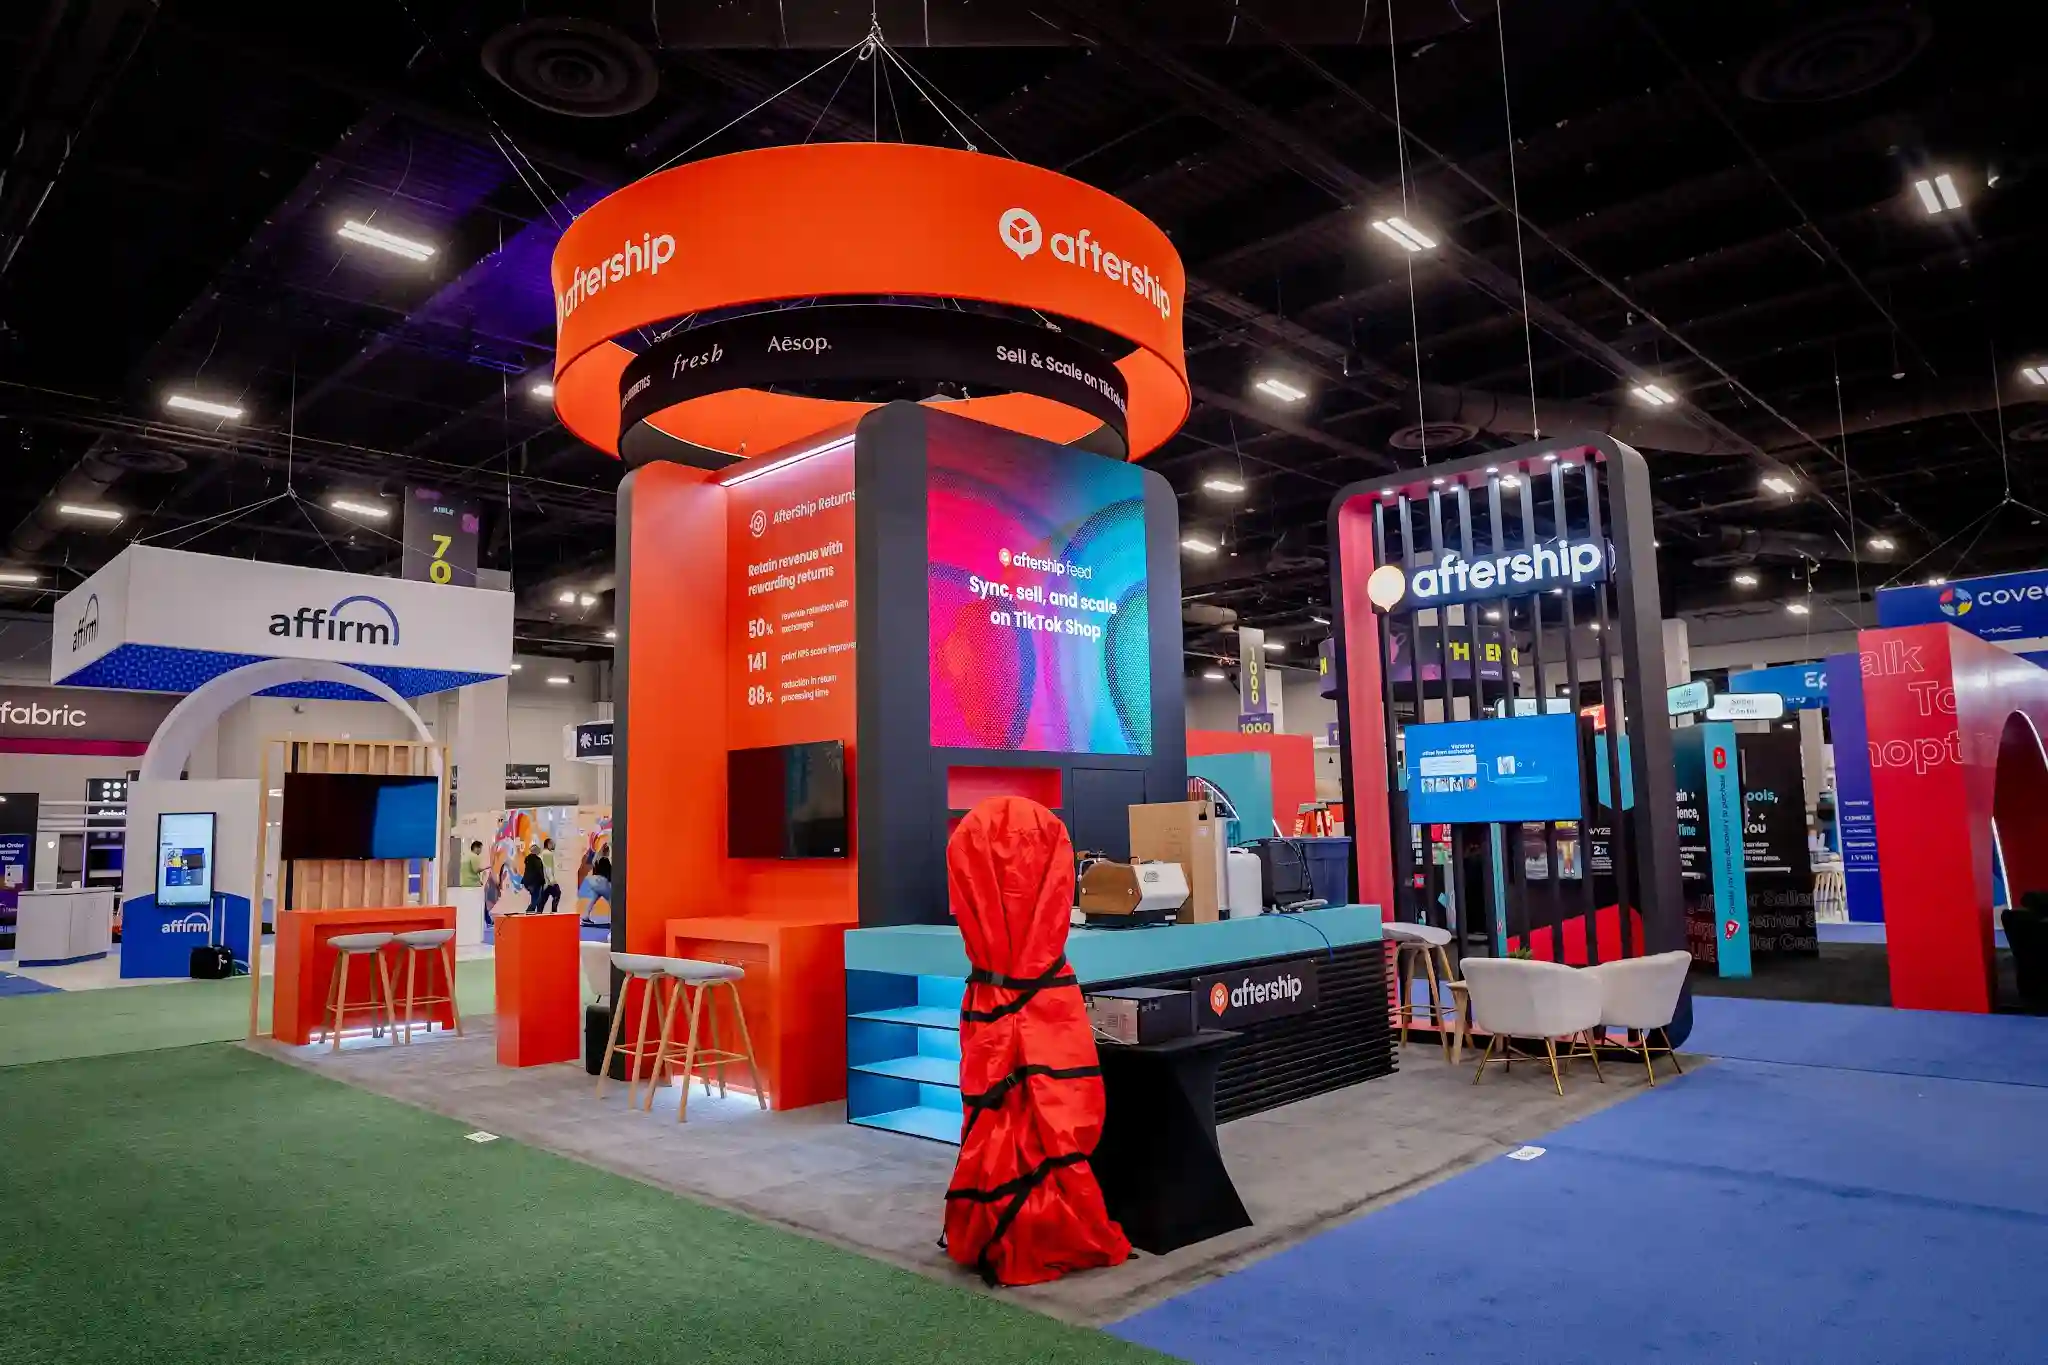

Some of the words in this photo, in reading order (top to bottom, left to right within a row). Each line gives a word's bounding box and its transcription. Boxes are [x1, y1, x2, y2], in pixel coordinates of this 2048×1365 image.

[565, 232, 676, 317] aftership
[1050, 228, 1171, 321] aftership
[672, 343, 723, 379] fresh
[768, 336, 832, 354] Aēsop.
[996, 345, 1027, 365] Sell
[1030, 352, 1043, 368] &
[1045, 356, 1082, 381] Scale
[1084, 372, 1097, 390] on
[773, 501, 816, 525] AfterShip
[818, 490, 856, 510] Returns
[748, 558, 777, 577] Retain
[778, 549, 819, 569] revenue
[820, 541, 843, 558] with
[1013, 552, 1065, 576] aftership
[1066, 560, 1092, 579] feed
[1412, 540, 1602, 598] aftership
[748, 574, 796, 597] rewarding
[797, 566, 835, 585] returns
[969, 575, 1013, 600] Sync,
[1016, 585, 1047, 606] sell,
[1049, 591, 1078, 609] and
[1080, 596, 1117, 615] scale
[1978, 584, 2048, 606] cove
[269, 604, 391, 646] affirm
[748, 618, 774, 639] 50%
[781, 608, 806, 621] revenue
[990, 611, 1011, 626] on
[1014, 610, 1062, 633] TikTok
[1065, 618, 1101, 643] Shop
[747, 651, 767, 673] 141
[829, 641, 857, 654] improve
[0, 701, 87, 727] fabric
[161, 919, 209, 934] affirm
[1230, 975, 1303, 1008] aftership
